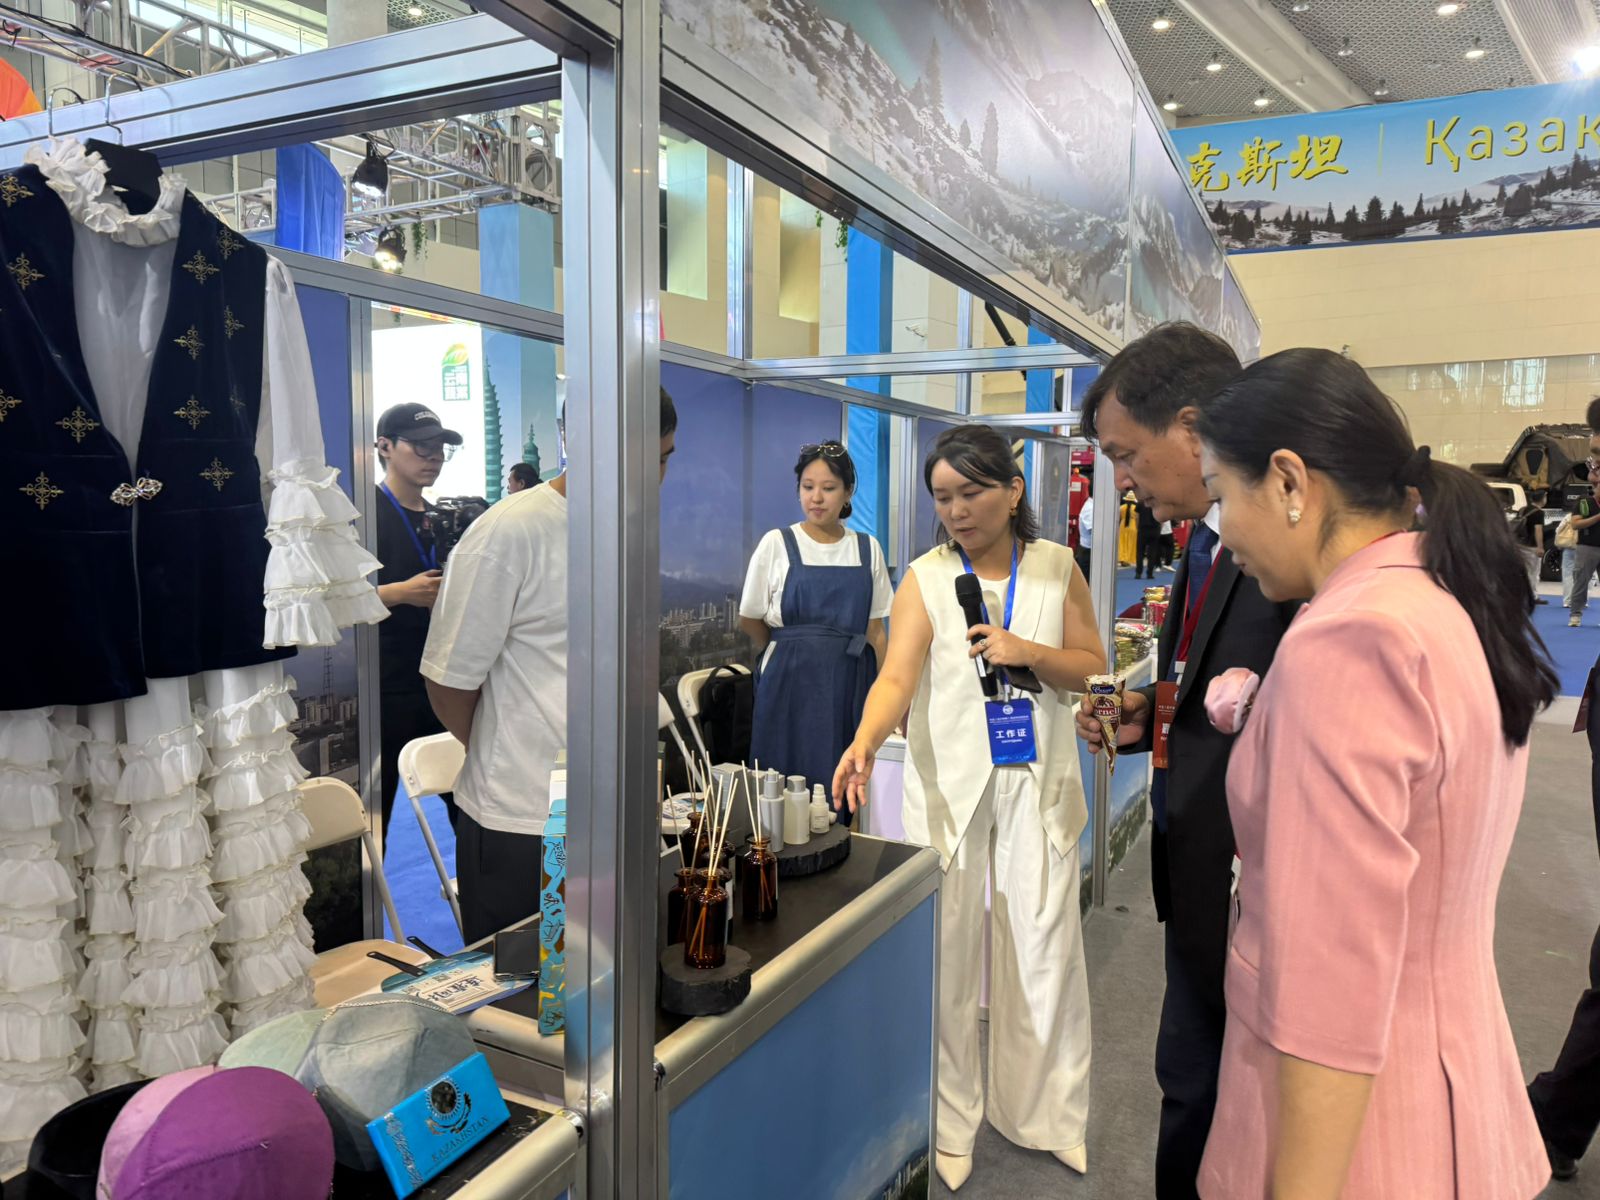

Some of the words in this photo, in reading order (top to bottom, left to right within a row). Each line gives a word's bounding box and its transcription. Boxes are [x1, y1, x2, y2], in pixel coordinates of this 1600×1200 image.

[1187, 134, 1348, 192] 克斯坦
[995, 728, 1027, 739] 工作证
[431, 1116, 489, 1163] KAZAKHSTAN
